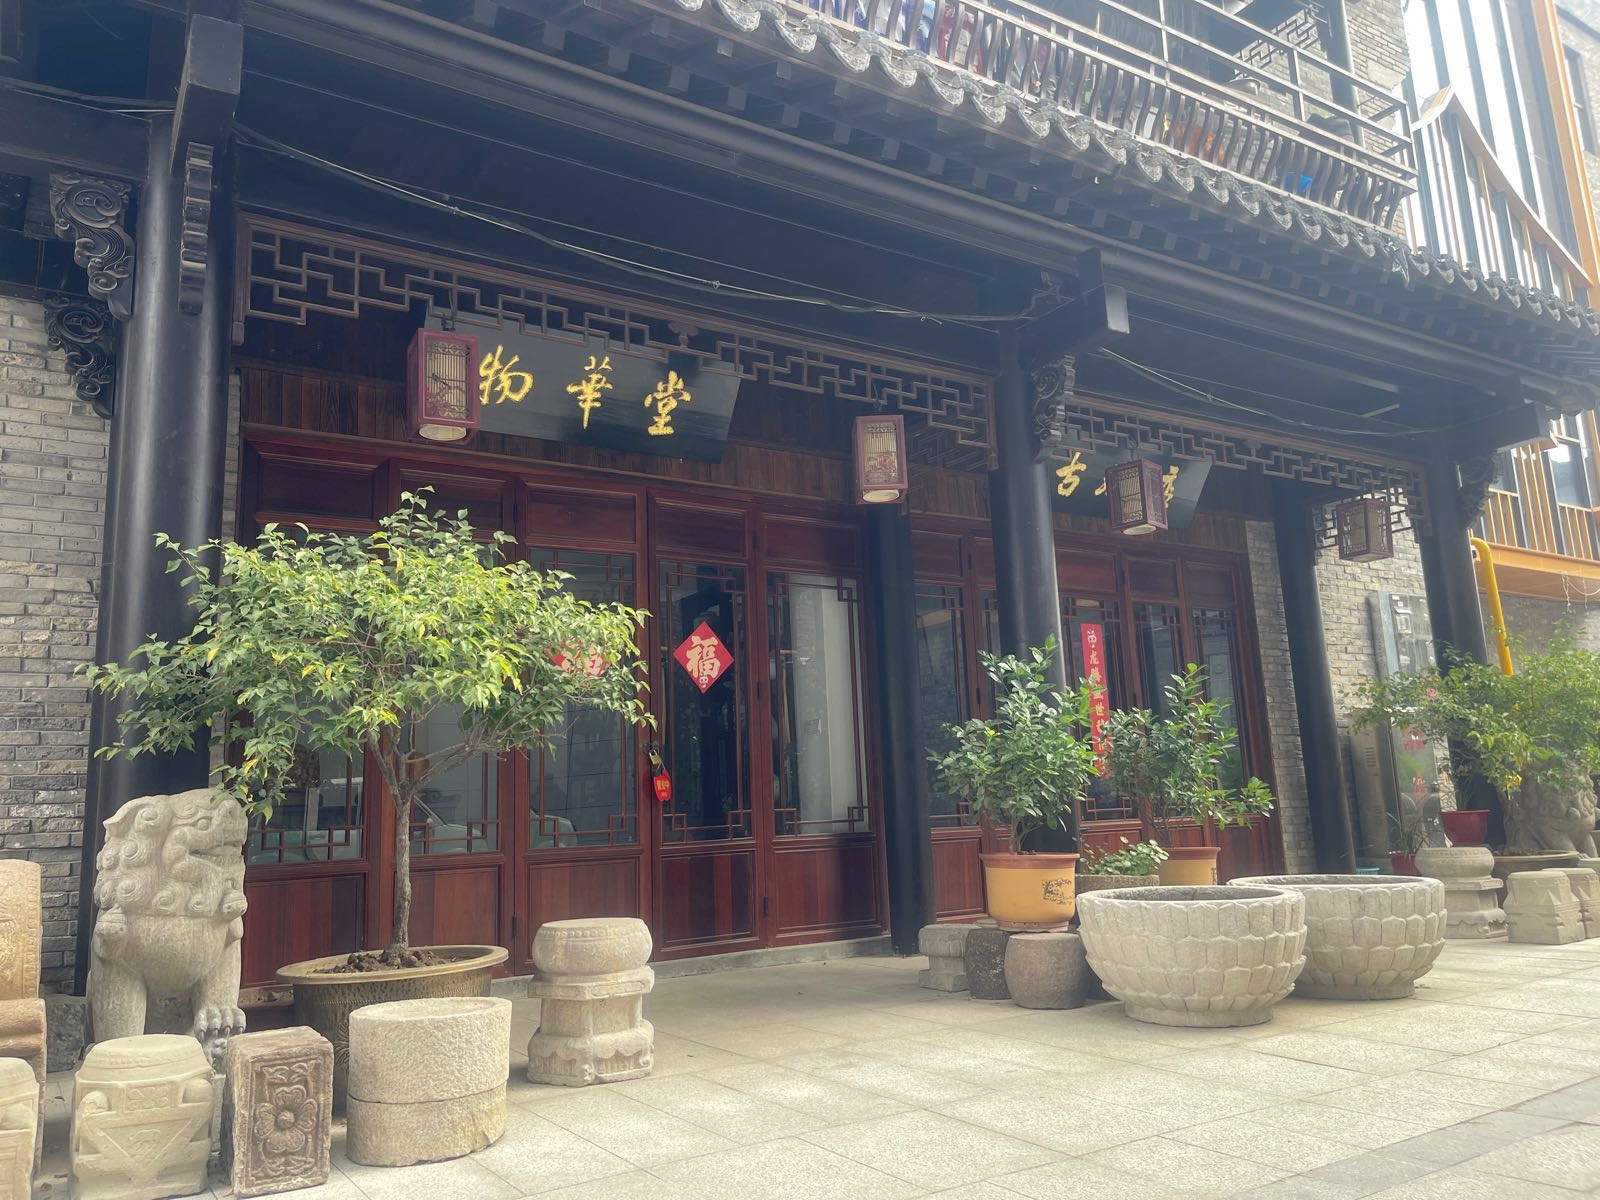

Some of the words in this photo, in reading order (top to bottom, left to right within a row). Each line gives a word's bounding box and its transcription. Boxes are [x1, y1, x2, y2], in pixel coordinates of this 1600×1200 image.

[479, 344, 692, 437] 物華堂
[685, 635, 721, 679] 福
